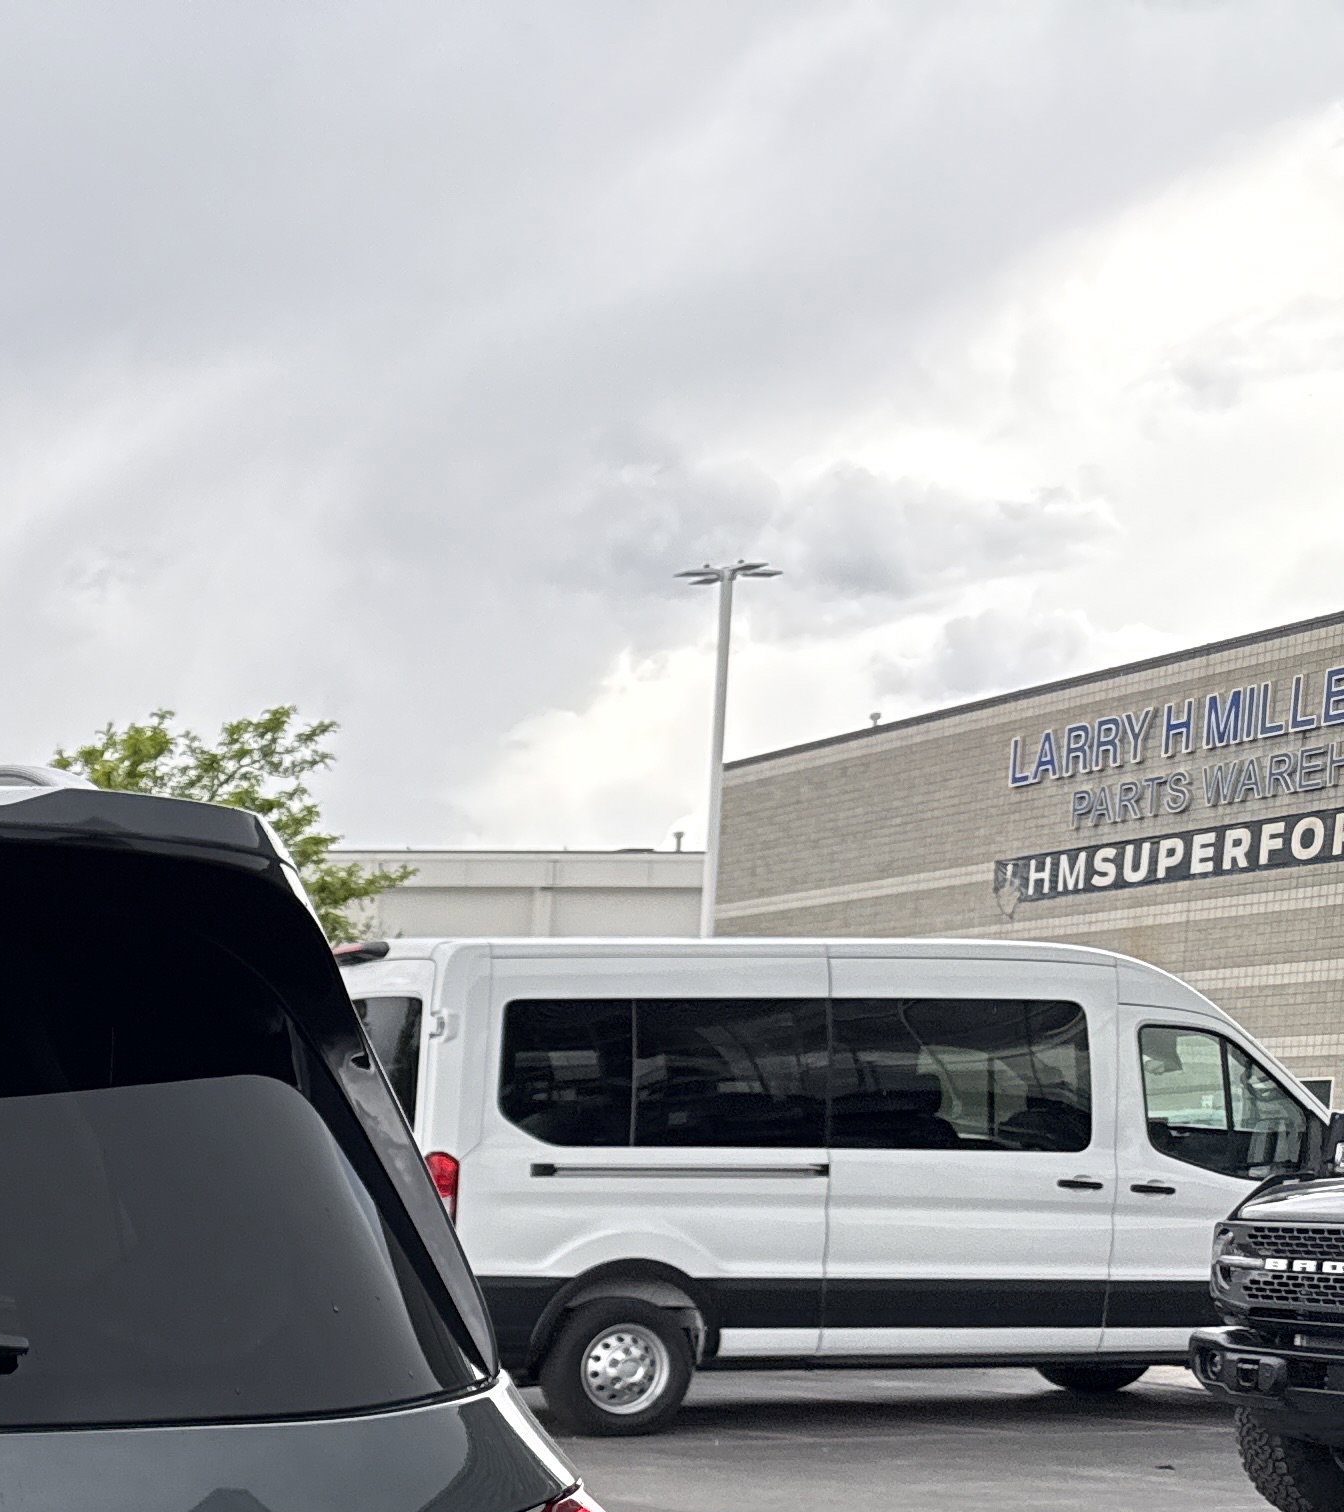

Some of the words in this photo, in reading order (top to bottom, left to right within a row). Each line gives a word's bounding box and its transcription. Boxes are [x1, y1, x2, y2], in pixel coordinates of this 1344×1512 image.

[1008, 706, 1153, 788] LARRY
[1161, 698, 1195, 757] H
[1202, 664, 1344, 749] MILLE
[1069, 769, 1190, 830] PARTS
